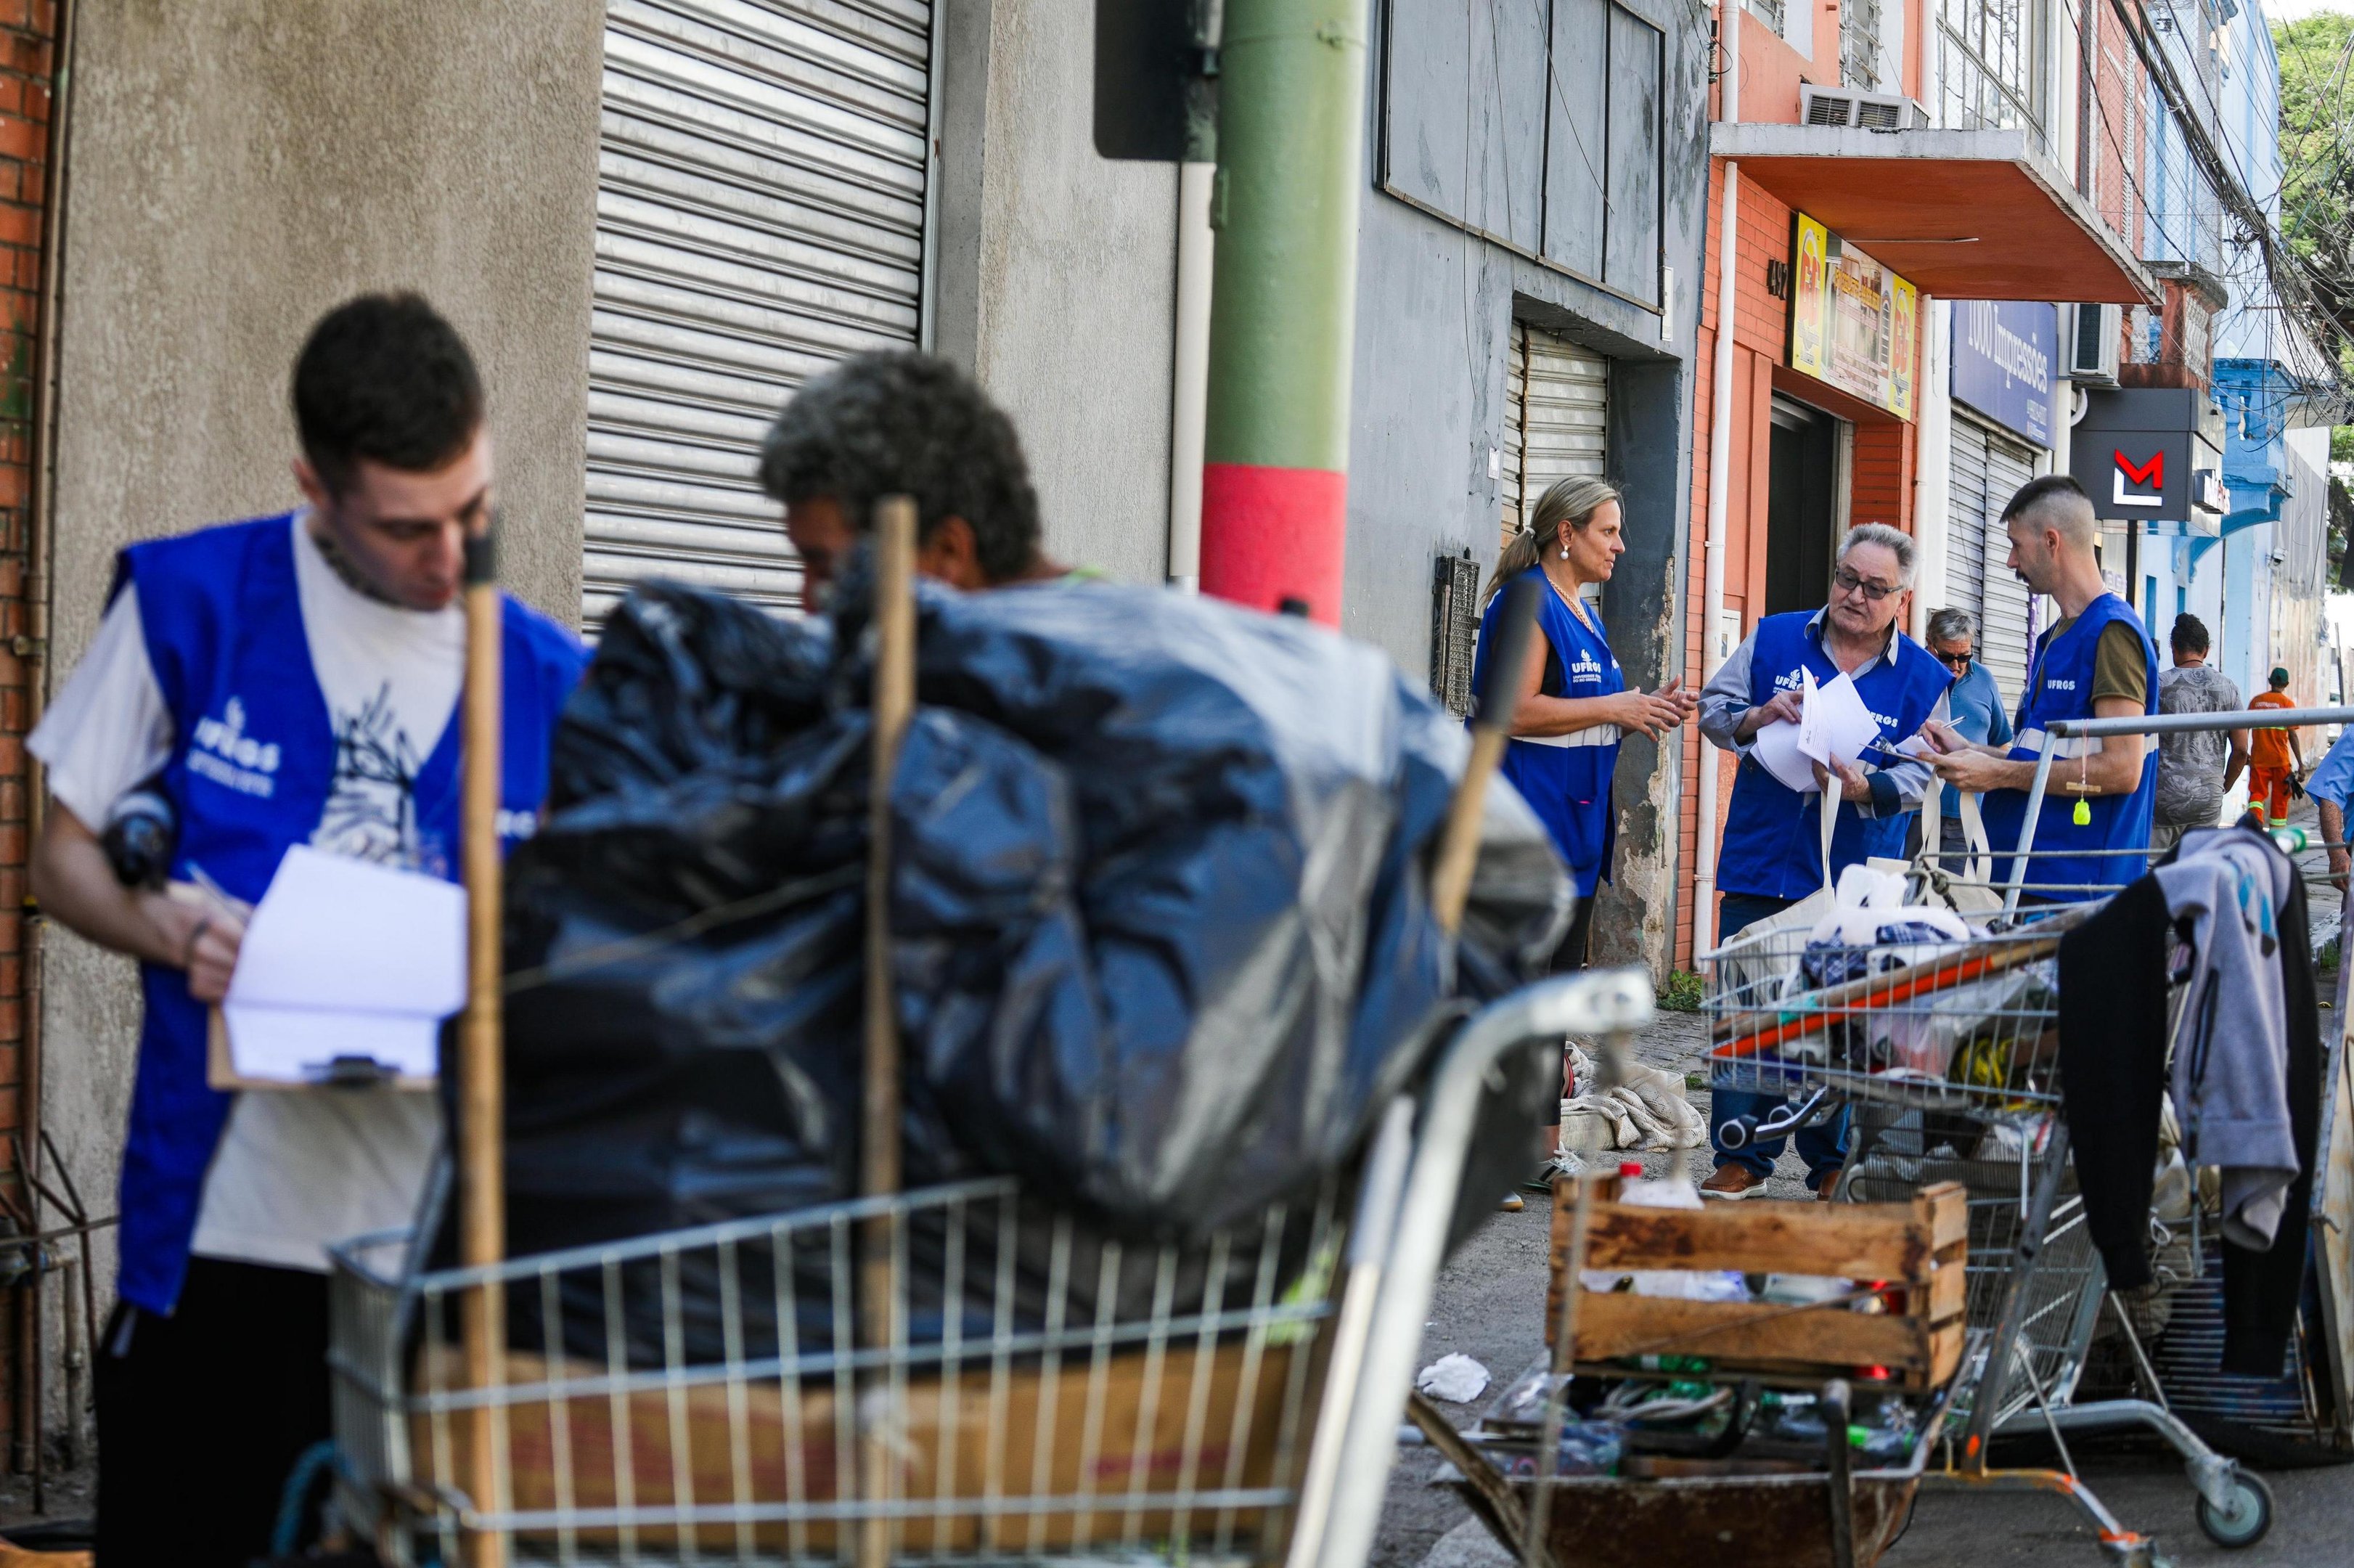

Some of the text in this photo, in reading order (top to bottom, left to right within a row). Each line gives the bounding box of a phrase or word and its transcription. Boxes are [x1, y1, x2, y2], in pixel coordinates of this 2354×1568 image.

[1770, 259, 1789, 301] 492
[1968, 301, 2048, 394] 1000 Impressões
[1775, 675, 1804, 690] UFR
[2047, 679, 2075, 690] UFRGS
[1869, 711, 1898, 728] FRGS
